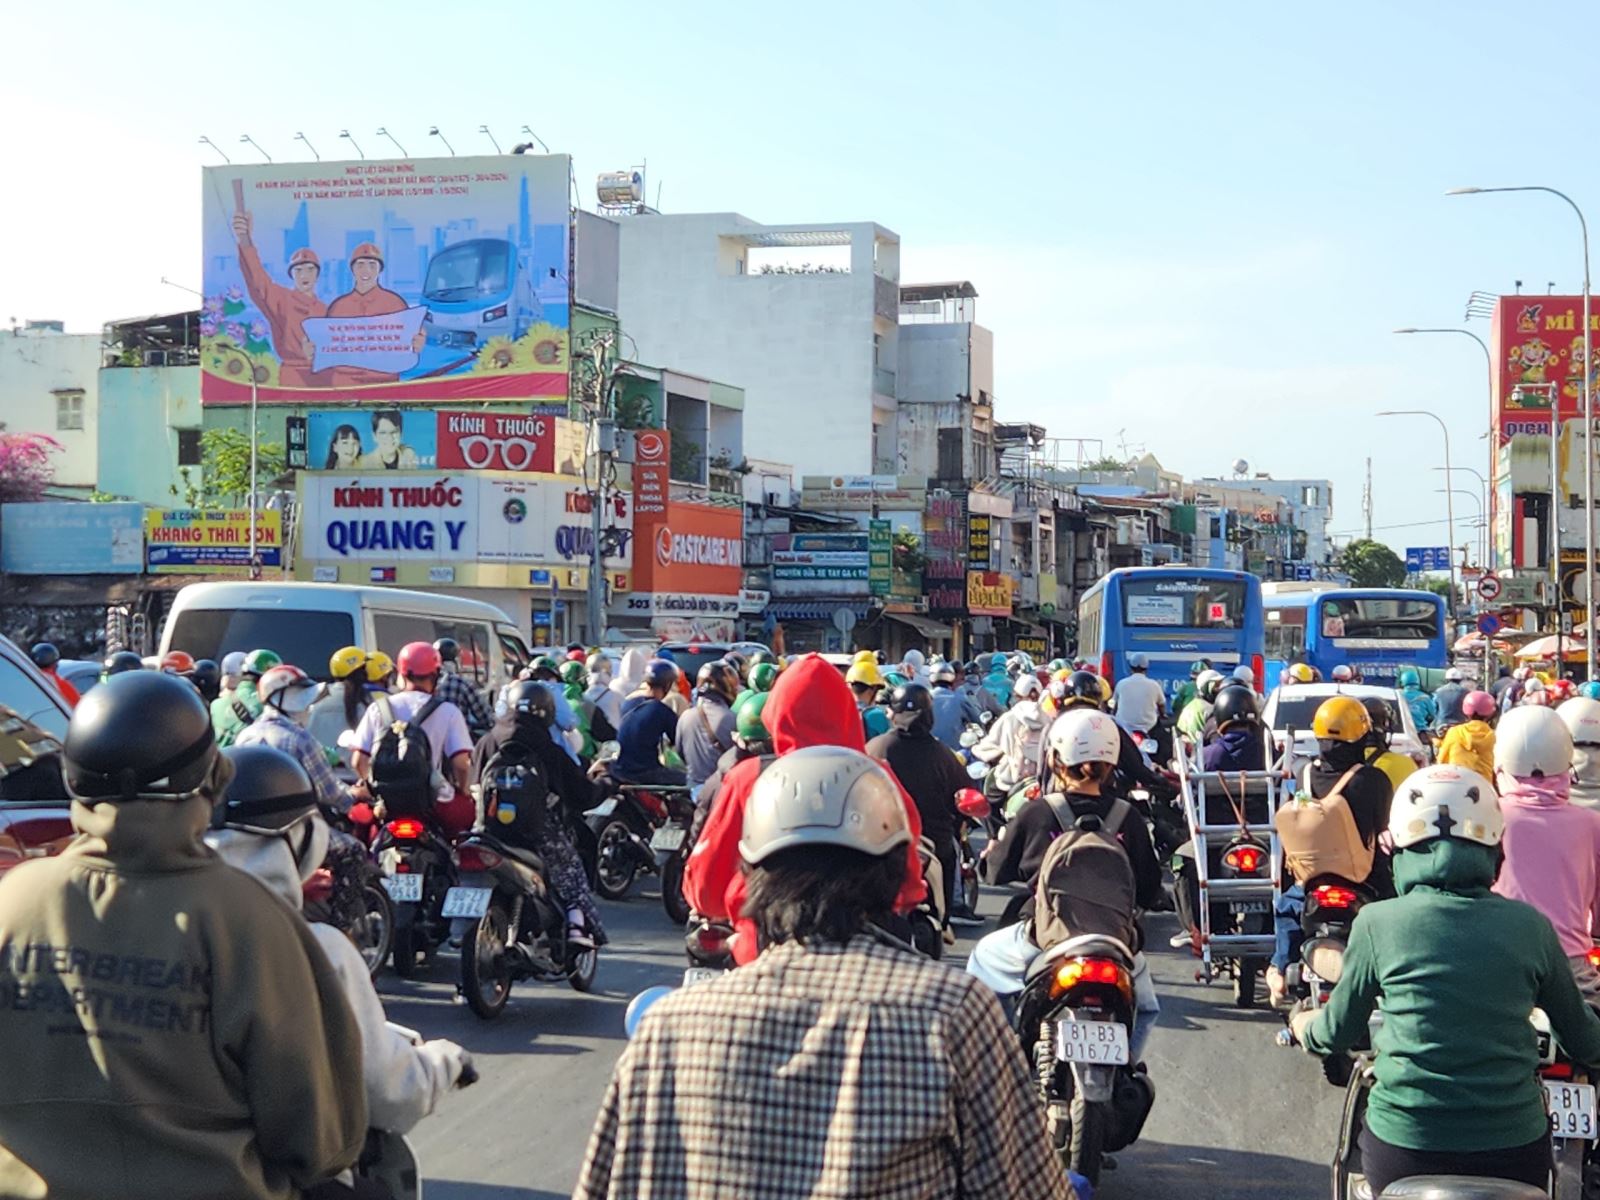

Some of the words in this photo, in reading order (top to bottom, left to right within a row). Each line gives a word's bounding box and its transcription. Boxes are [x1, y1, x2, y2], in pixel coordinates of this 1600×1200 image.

[448, 412, 486, 434] KÍNH
[495, 415, 546, 436] THUỐC
[333, 480, 384, 509] KÍNH
[388, 476, 463, 508] THUỐC
[152, 526, 203, 543] KHANG
[326, 519, 436, 555] QUANG
[444, 520, 467, 551] Y
[1071, 1024, 1116, 1042] 81-B3
